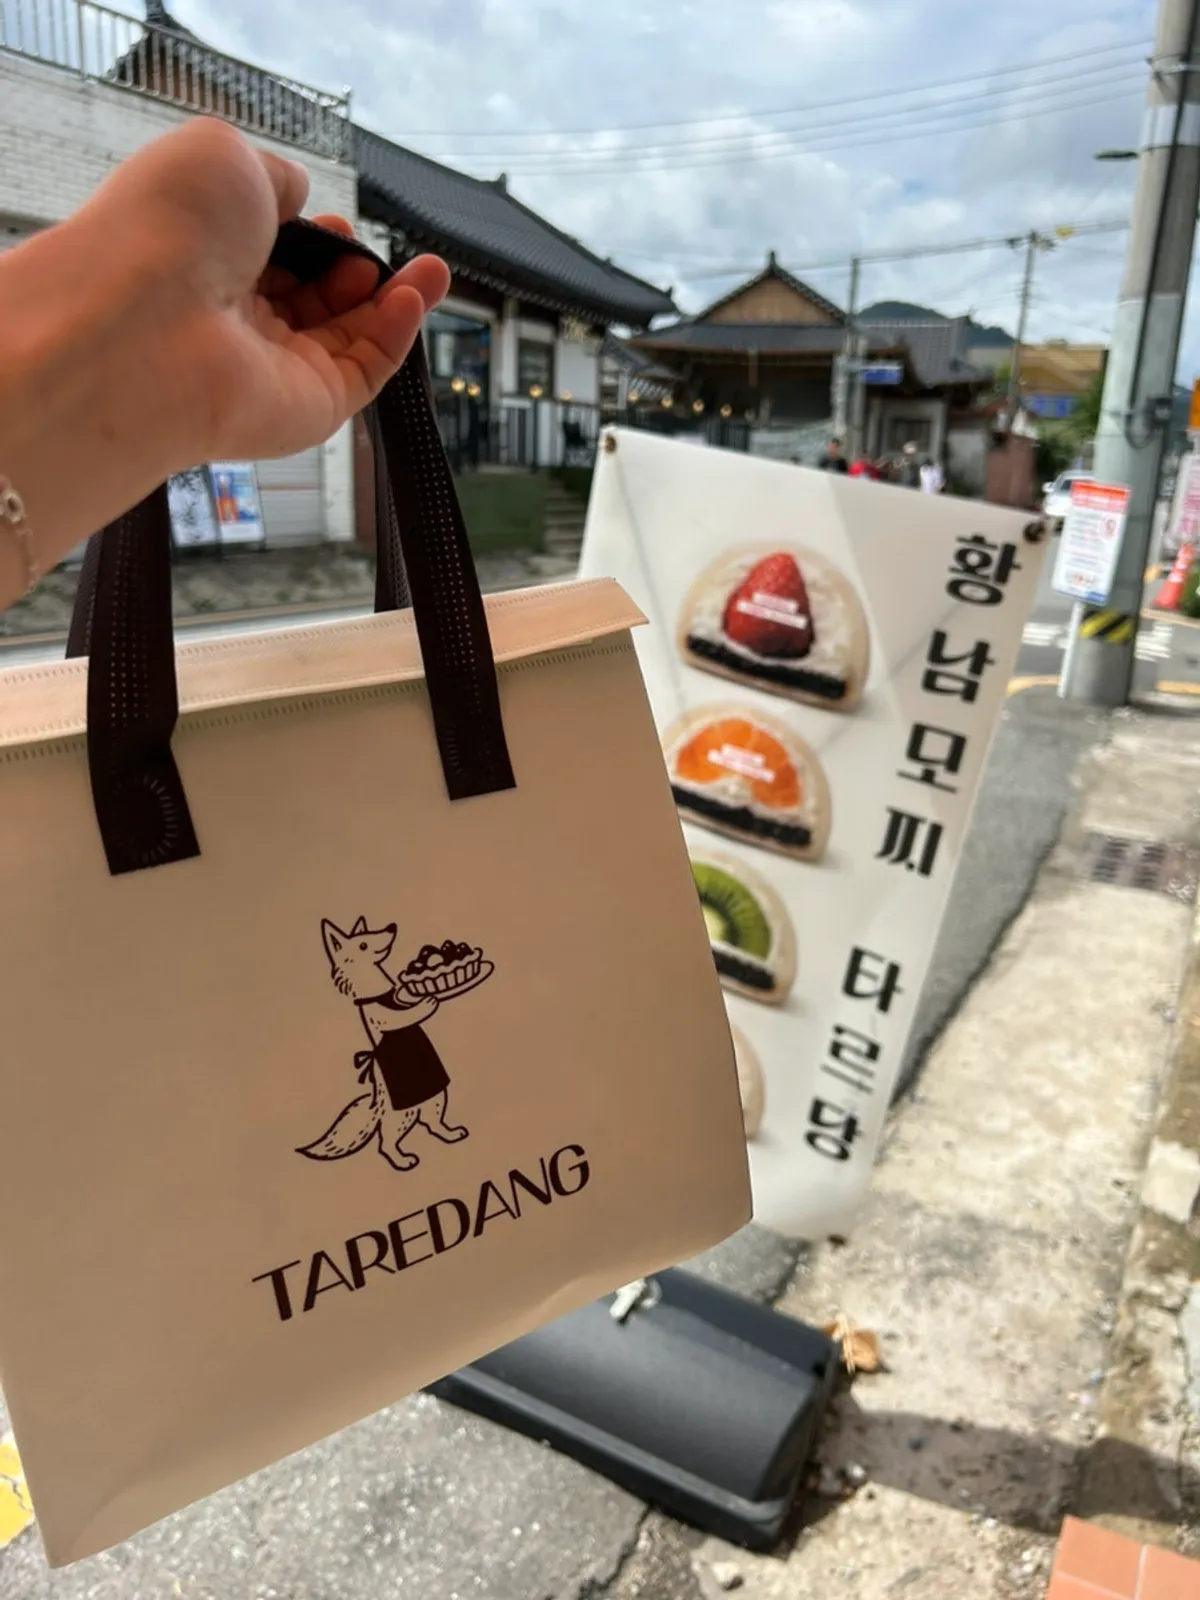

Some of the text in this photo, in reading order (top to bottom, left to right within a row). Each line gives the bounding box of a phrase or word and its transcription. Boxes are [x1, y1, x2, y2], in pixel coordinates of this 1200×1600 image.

[804, 533, 1022, 1161] 황남모찌 타르당
[252, 1144, 591, 1321] TAREDANG
